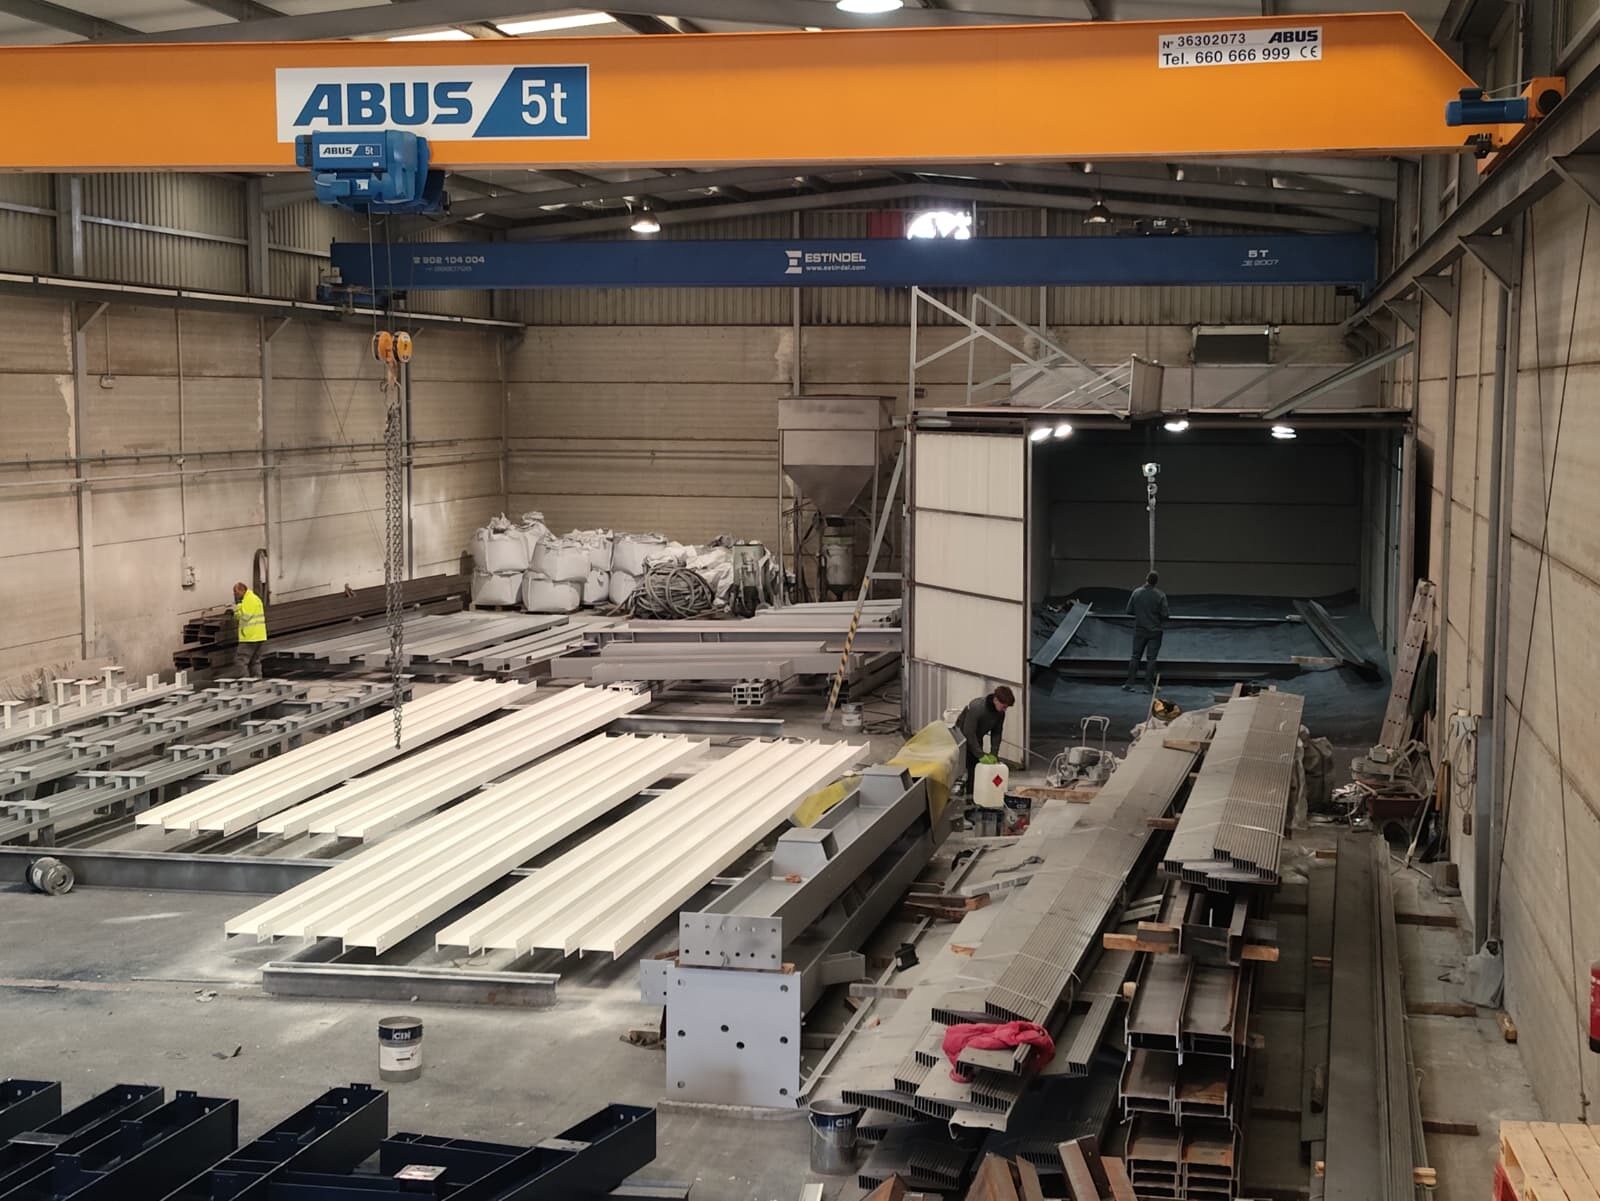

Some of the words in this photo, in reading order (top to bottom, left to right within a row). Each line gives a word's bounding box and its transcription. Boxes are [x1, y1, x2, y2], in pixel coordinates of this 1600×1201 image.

[1178, 33, 1246, 47] 36302073
[1268, 30, 1318, 44] ABUS
[1163, 52, 1189, 65] Tel.
[1195, 50, 1223, 63] 660
[1228, 49, 1256, 62] 666
[1262, 47, 1290, 60] 999
[293, 81, 474, 127] ABUS
[521, 78, 567, 126] 5t
[323, 147, 352, 155] ABUS
[365, 145, 374, 155] 5t
[444, 256, 463, 264] 104
[465, 256, 485, 264] 004
[805, 252, 866, 263] ESTINDEL
[394, 1032, 411, 1040] CIN
